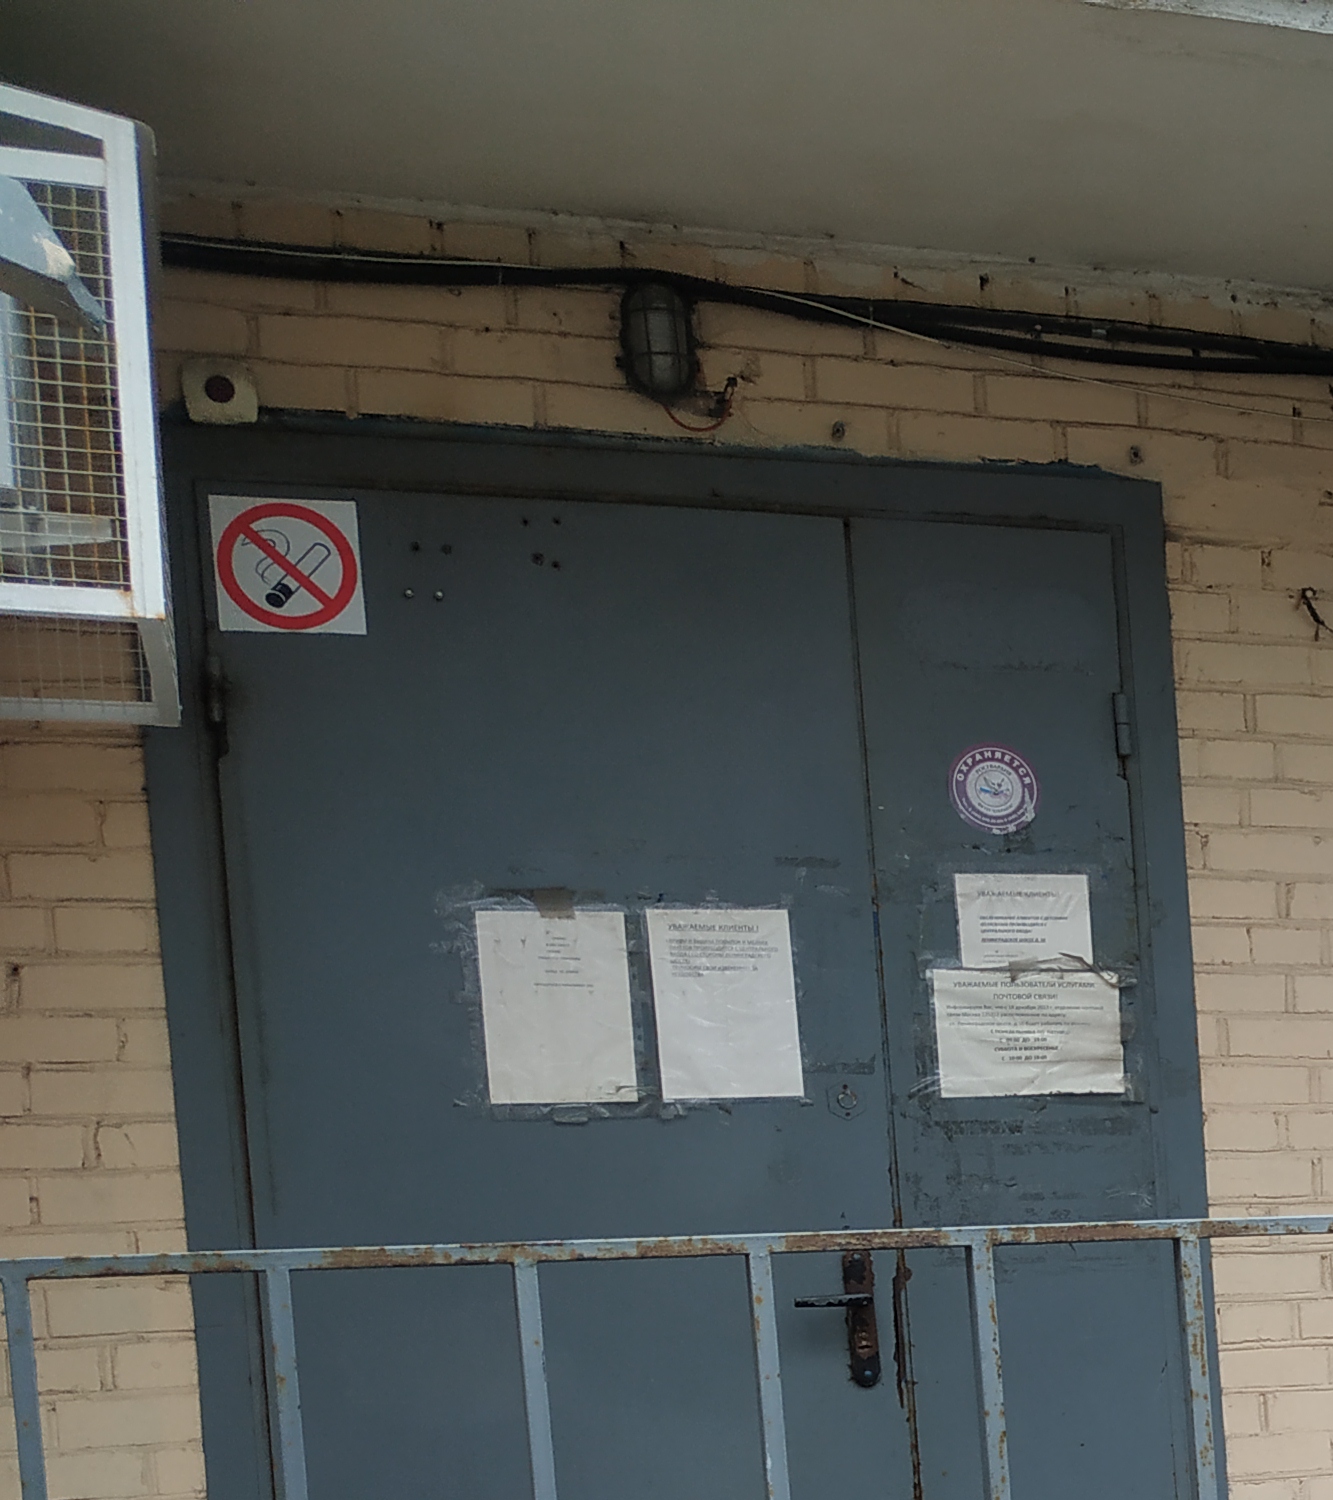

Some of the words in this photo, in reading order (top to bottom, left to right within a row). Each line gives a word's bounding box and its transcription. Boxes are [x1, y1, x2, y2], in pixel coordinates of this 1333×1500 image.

[957, 751, 1031, 784] ОХРАНЯЕТСЯ
[1000, 981, 1056, 989] ПОЛЬЗОВАТЕЛИ
[993, 992, 1032, 1000] ПОЧТОВОЙ
